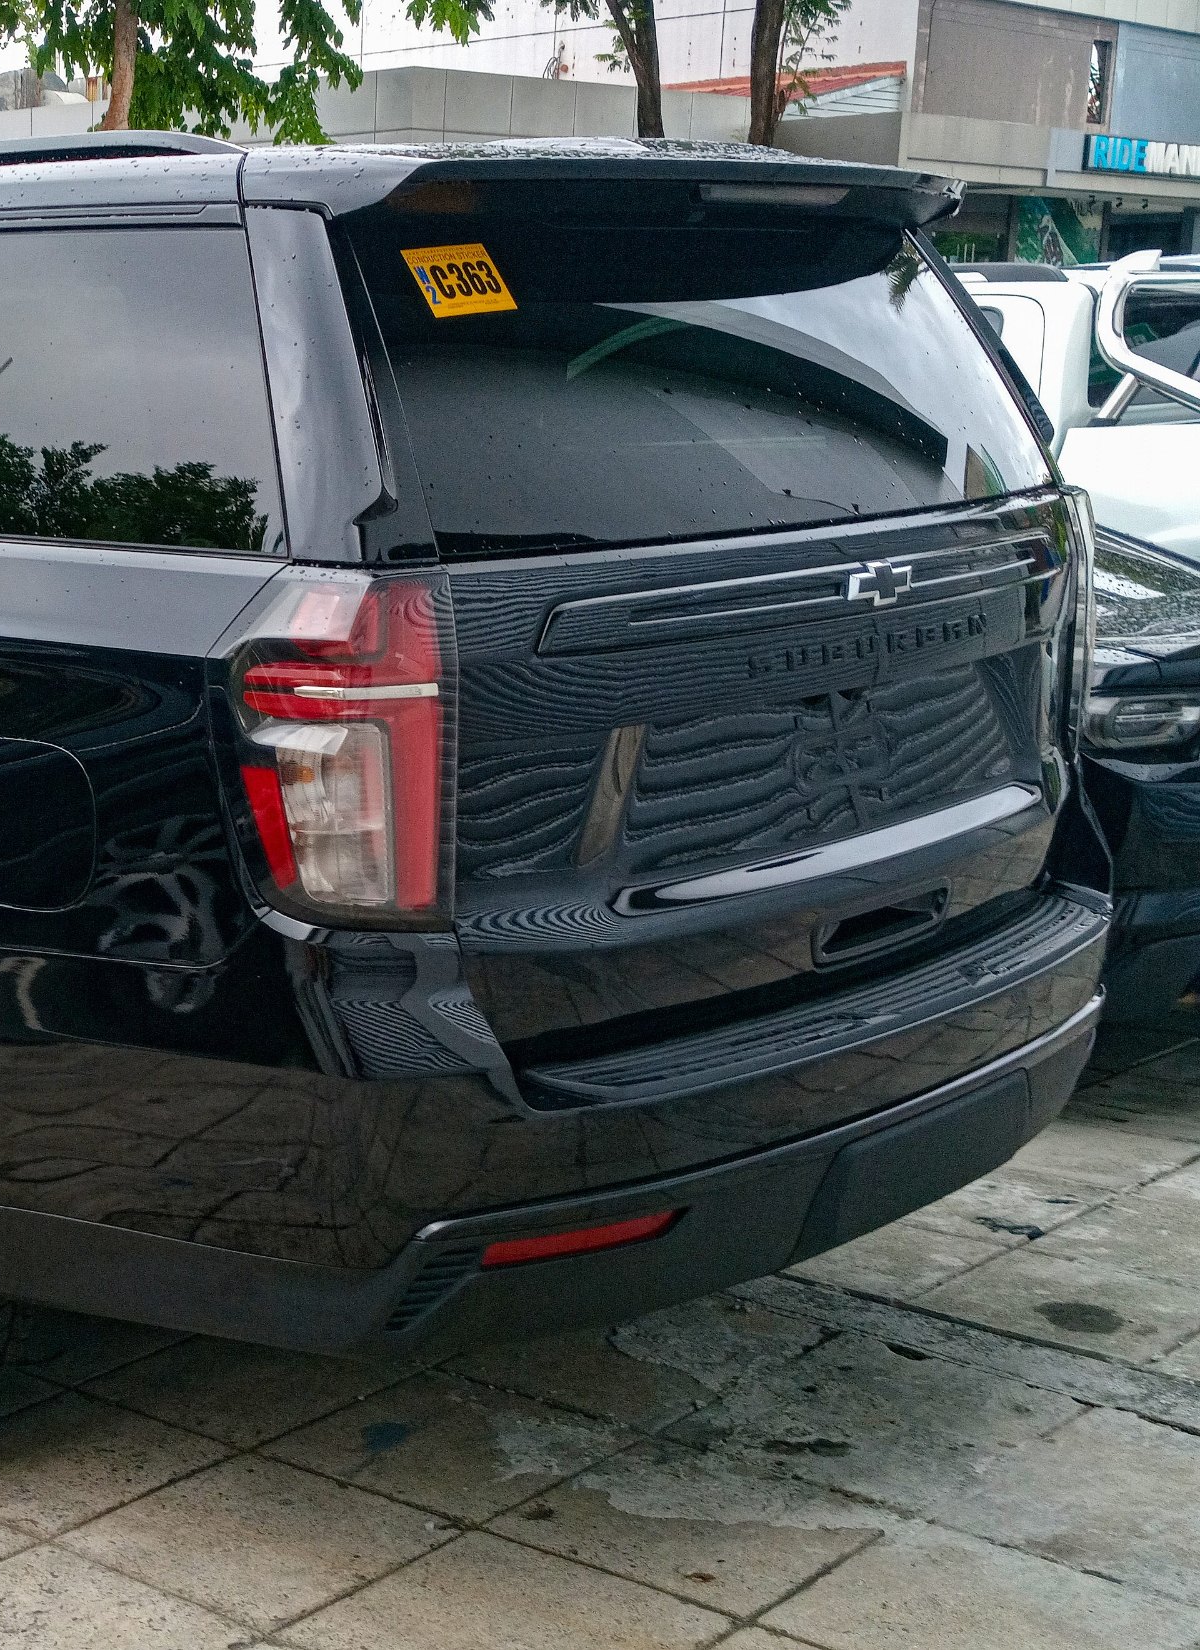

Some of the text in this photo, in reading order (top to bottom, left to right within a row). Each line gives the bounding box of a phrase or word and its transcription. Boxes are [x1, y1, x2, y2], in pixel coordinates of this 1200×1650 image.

[406, 252, 457, 265] CONDUCTION
[457, 249, 488, 260] STICKER
[429, 260, 502, 299] C363
